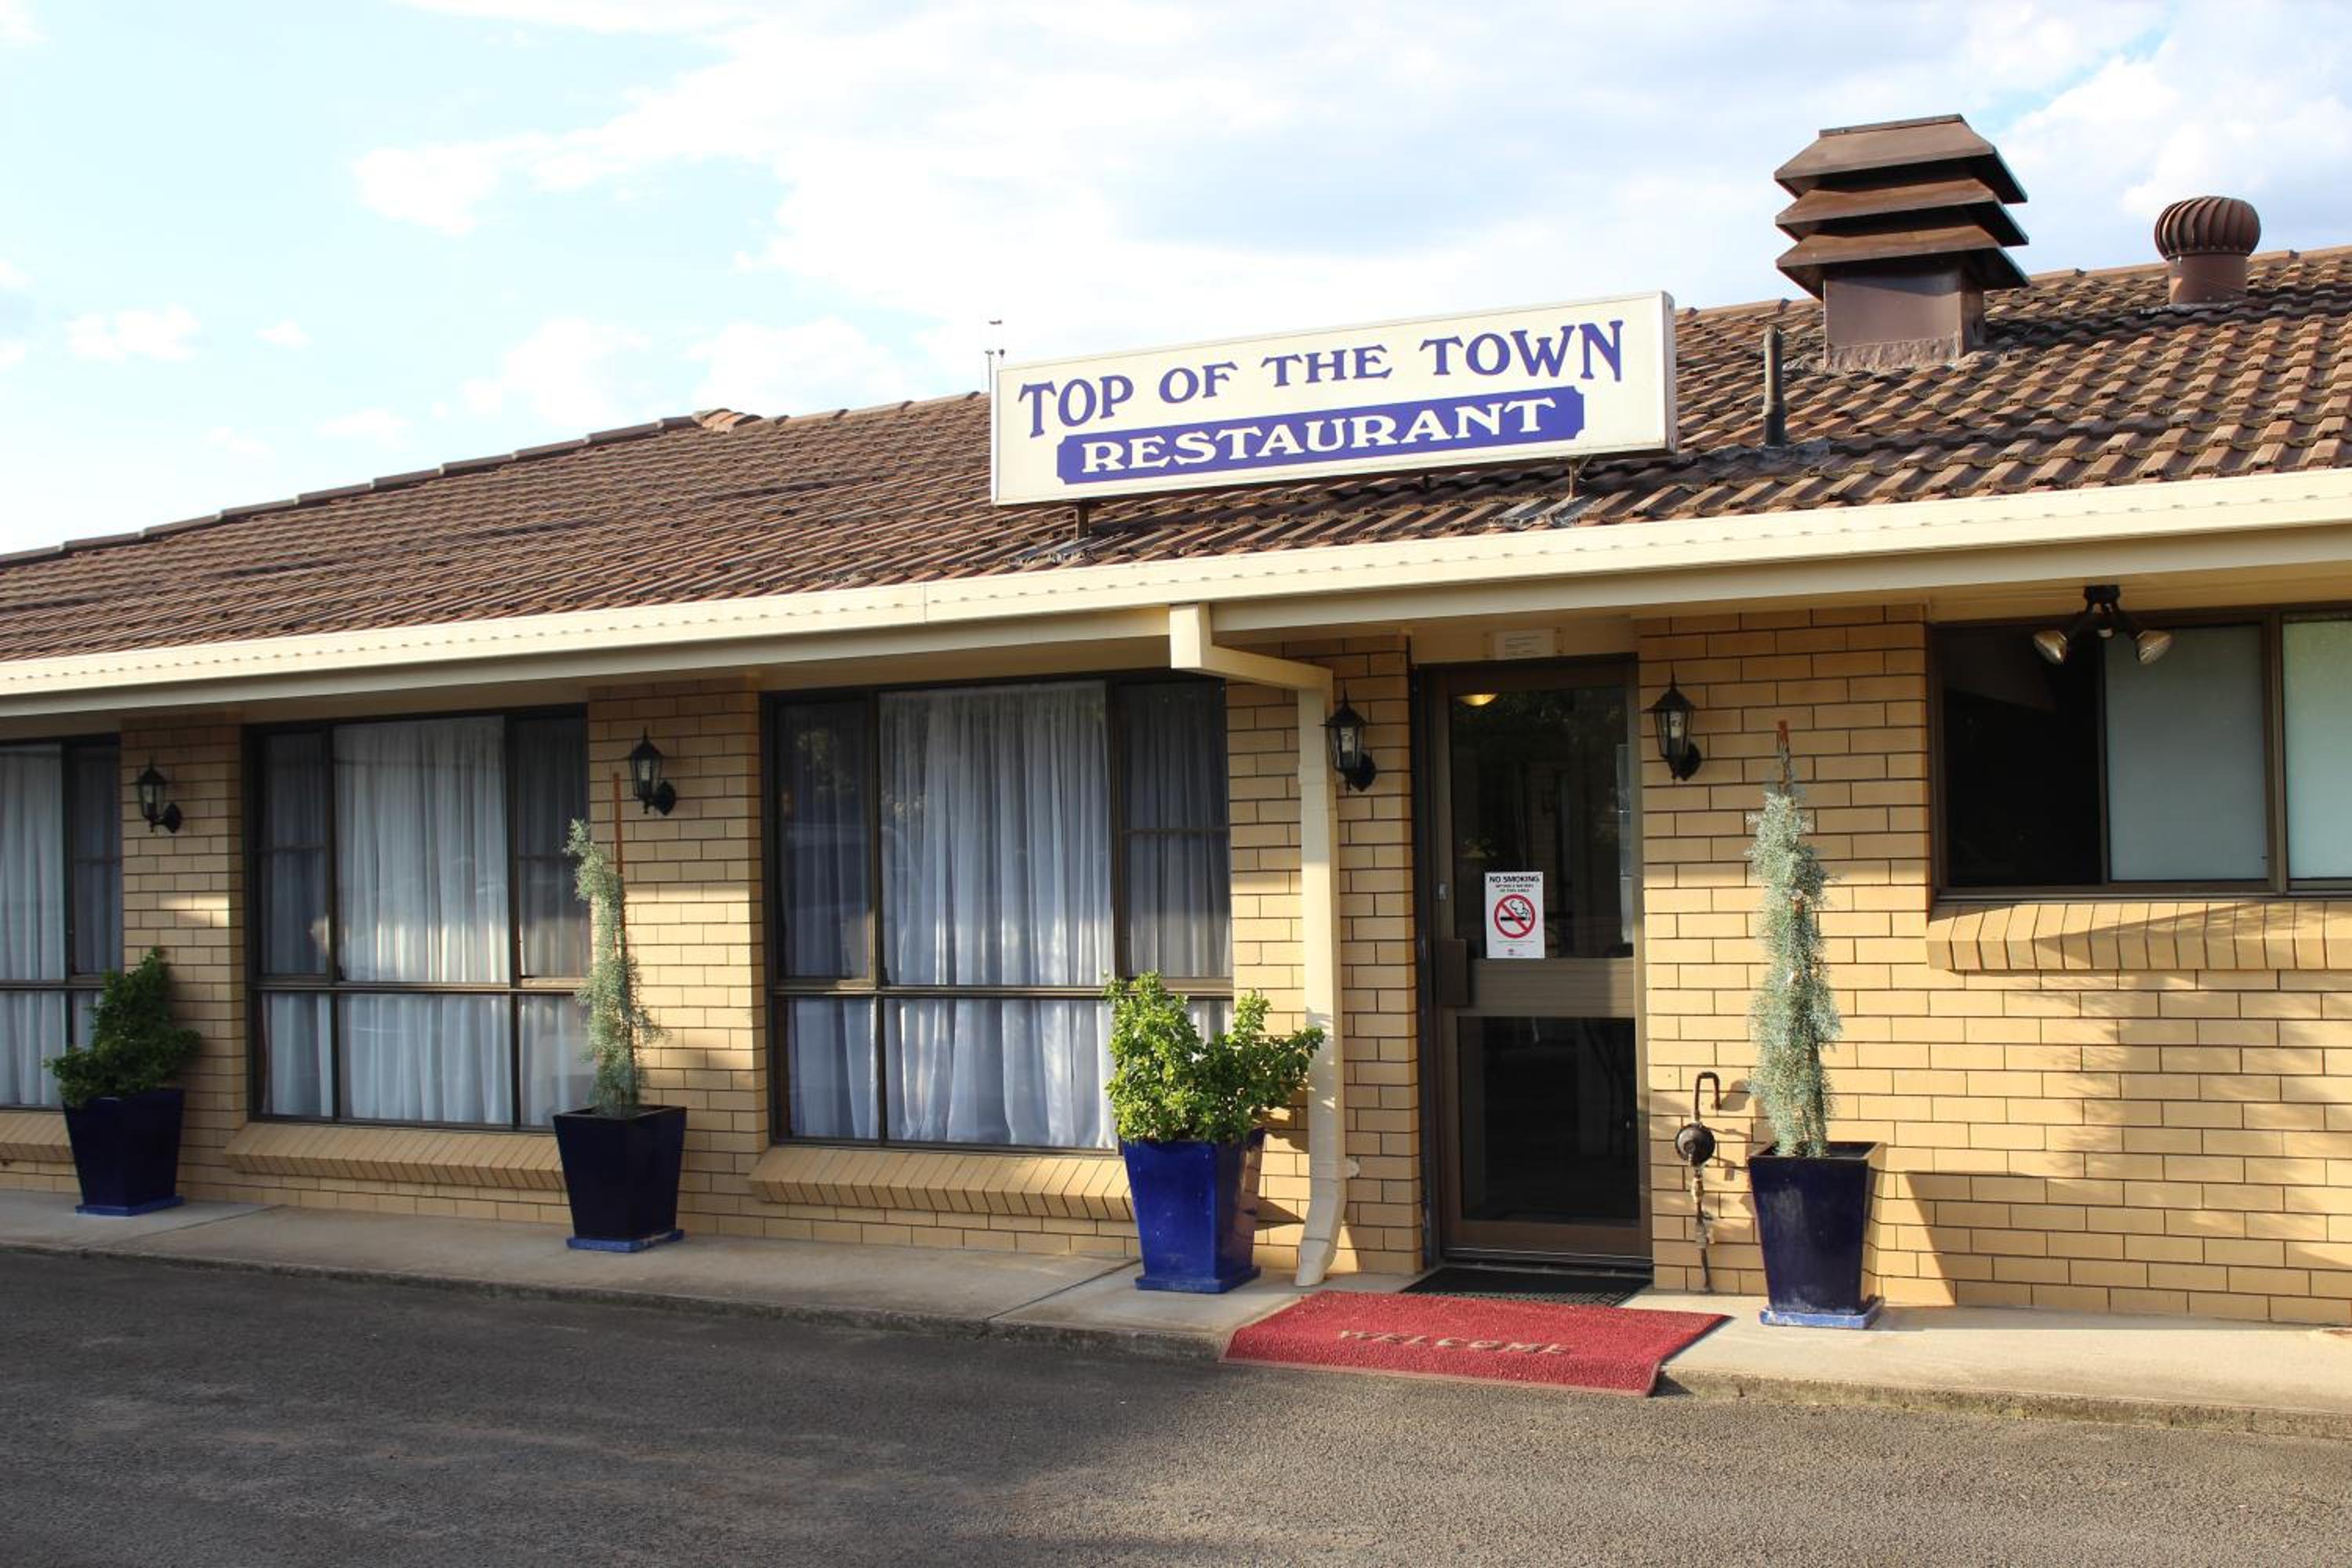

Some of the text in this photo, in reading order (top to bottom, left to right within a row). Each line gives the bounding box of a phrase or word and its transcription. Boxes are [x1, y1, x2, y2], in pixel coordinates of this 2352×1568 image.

[1018, 320, 1624, 438] TOP OF THE TOWN
[1081, 397, 1557, 474] RESTAURANT
[1338, 1330, 1569, 1356] WELCOME
